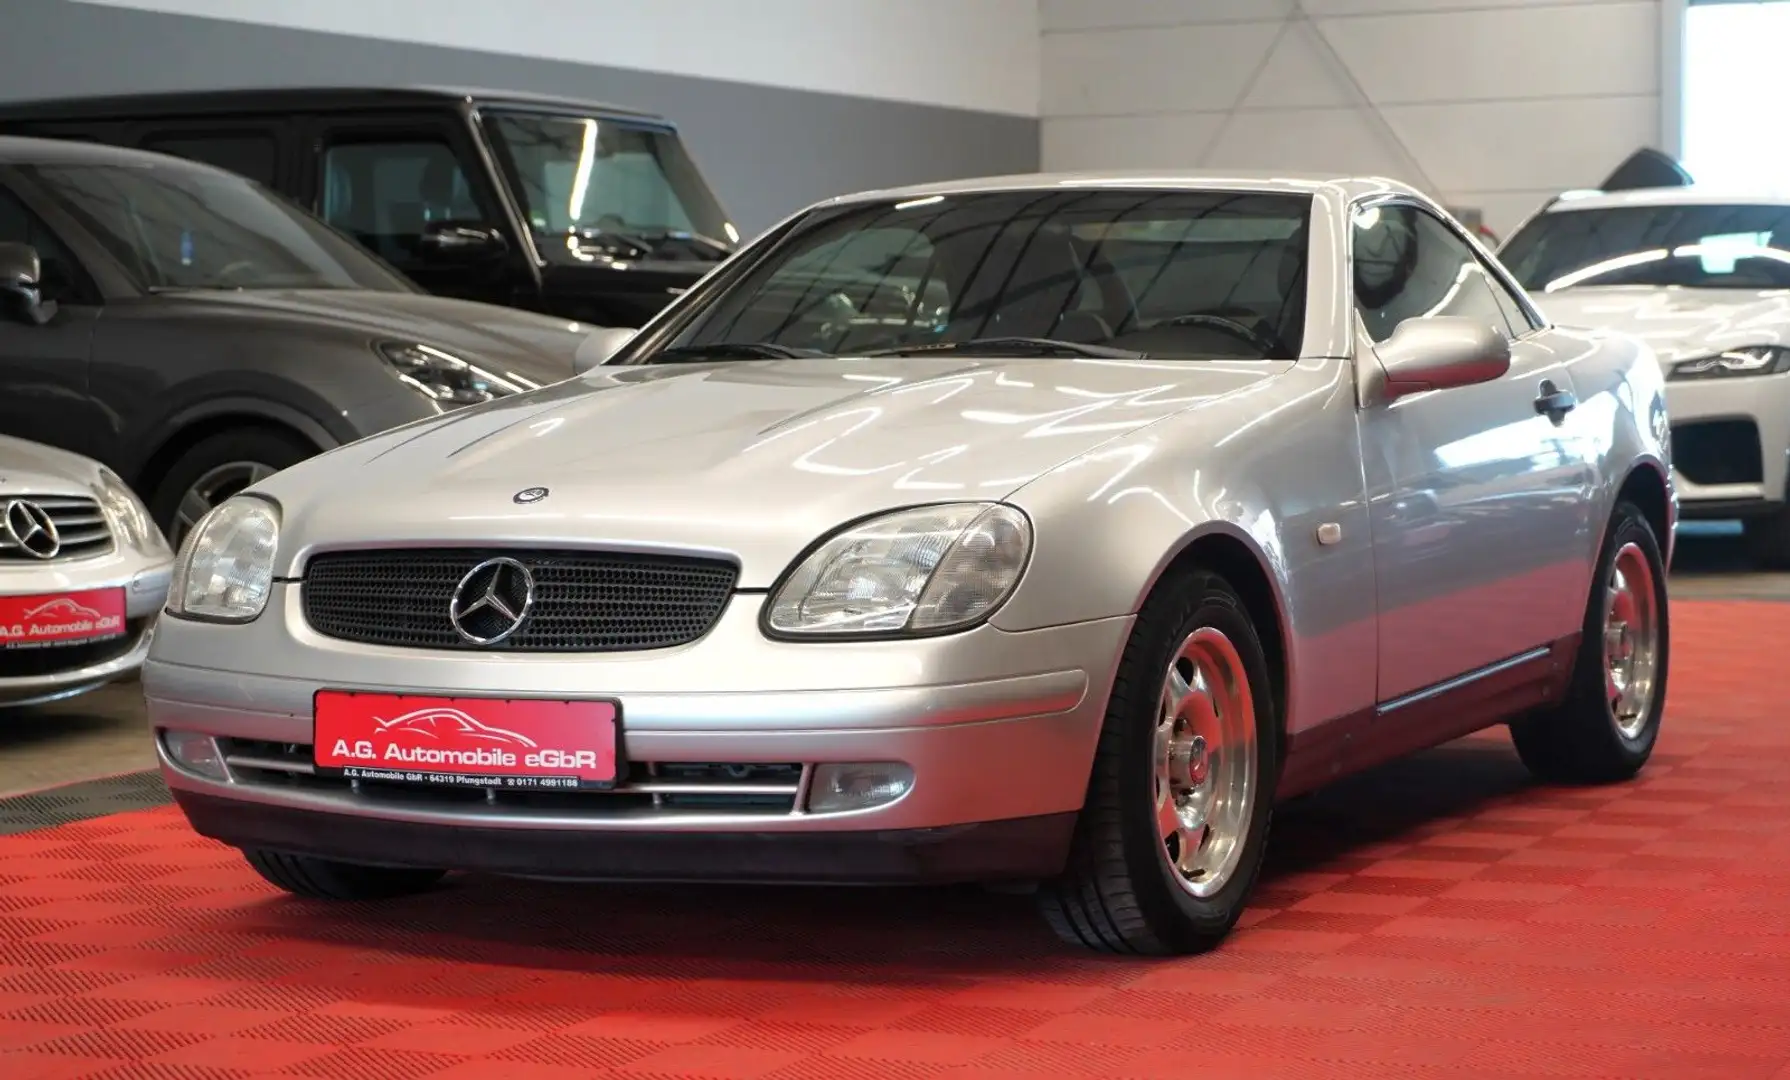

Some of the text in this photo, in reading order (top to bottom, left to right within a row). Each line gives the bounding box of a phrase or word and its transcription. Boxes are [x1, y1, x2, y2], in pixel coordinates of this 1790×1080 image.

[29, 619, 93, 636] Automobile
[332, 739, 597, 769] A.G. Automobile eGbR
[343, 769, 359, 777] A.G.
[361, 770, 404, 780] Automobile
[406, 773, 423, 782] GbR
[456, 775, 502, 786] Pfungstadt
[516, 778, 537, 787] 0171
